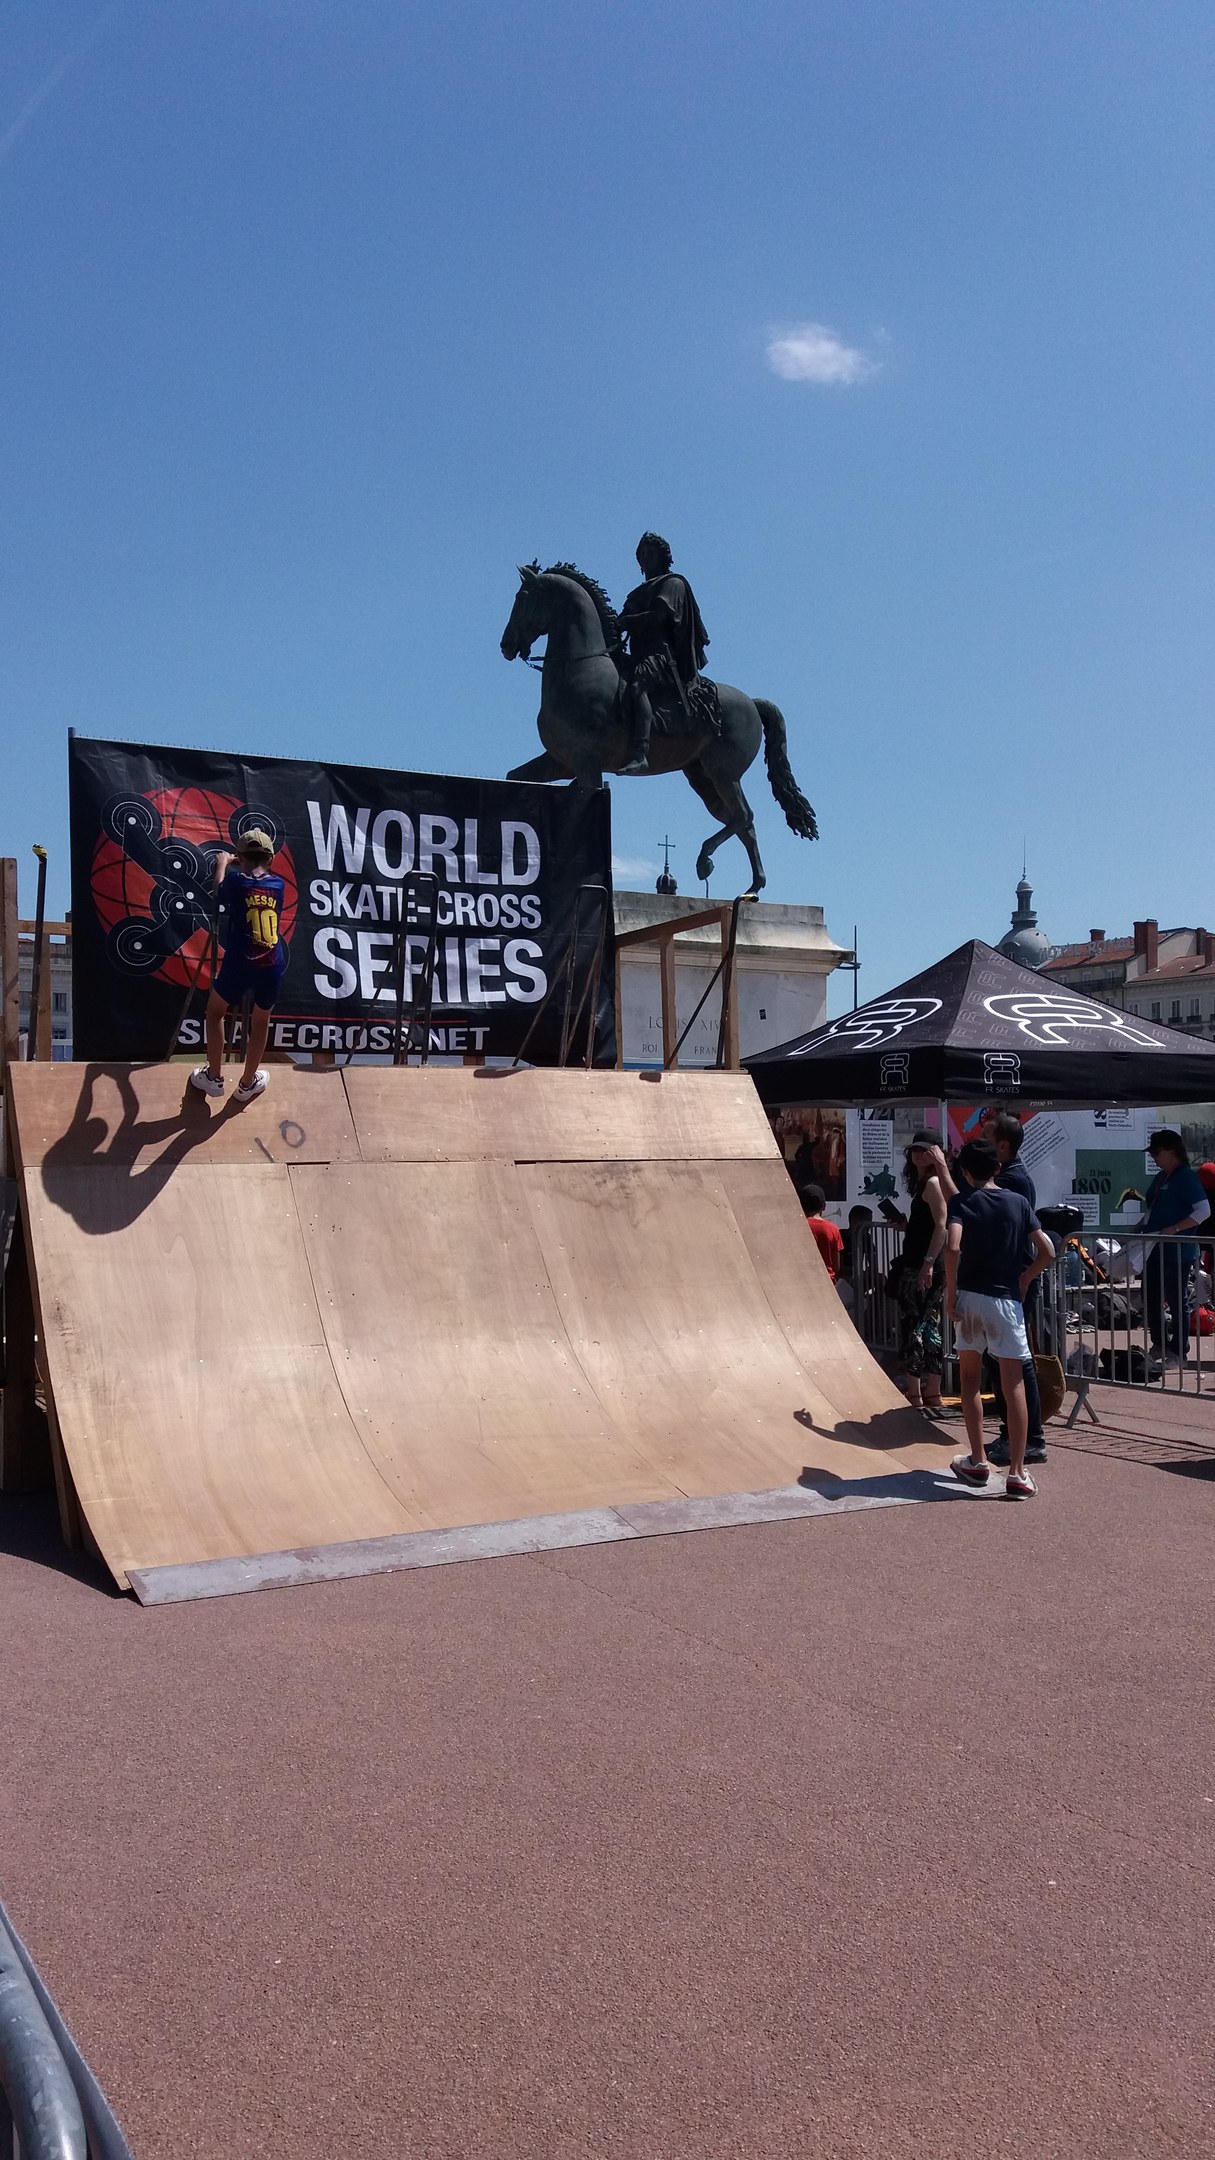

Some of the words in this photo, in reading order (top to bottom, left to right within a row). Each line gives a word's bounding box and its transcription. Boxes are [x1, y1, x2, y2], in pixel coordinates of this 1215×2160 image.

[306, 800, 541, 886] WORLD
[245, 894, 277, 909] MESSI
[246, 908, 278, 945] 10
[312, 927, 548, 1004] SERIES
[642, 1043, 658, 1053] ROI
[996, 1086, 1020, 1094] SKATES
[1072, 1178, 1112, 1195] 1800
